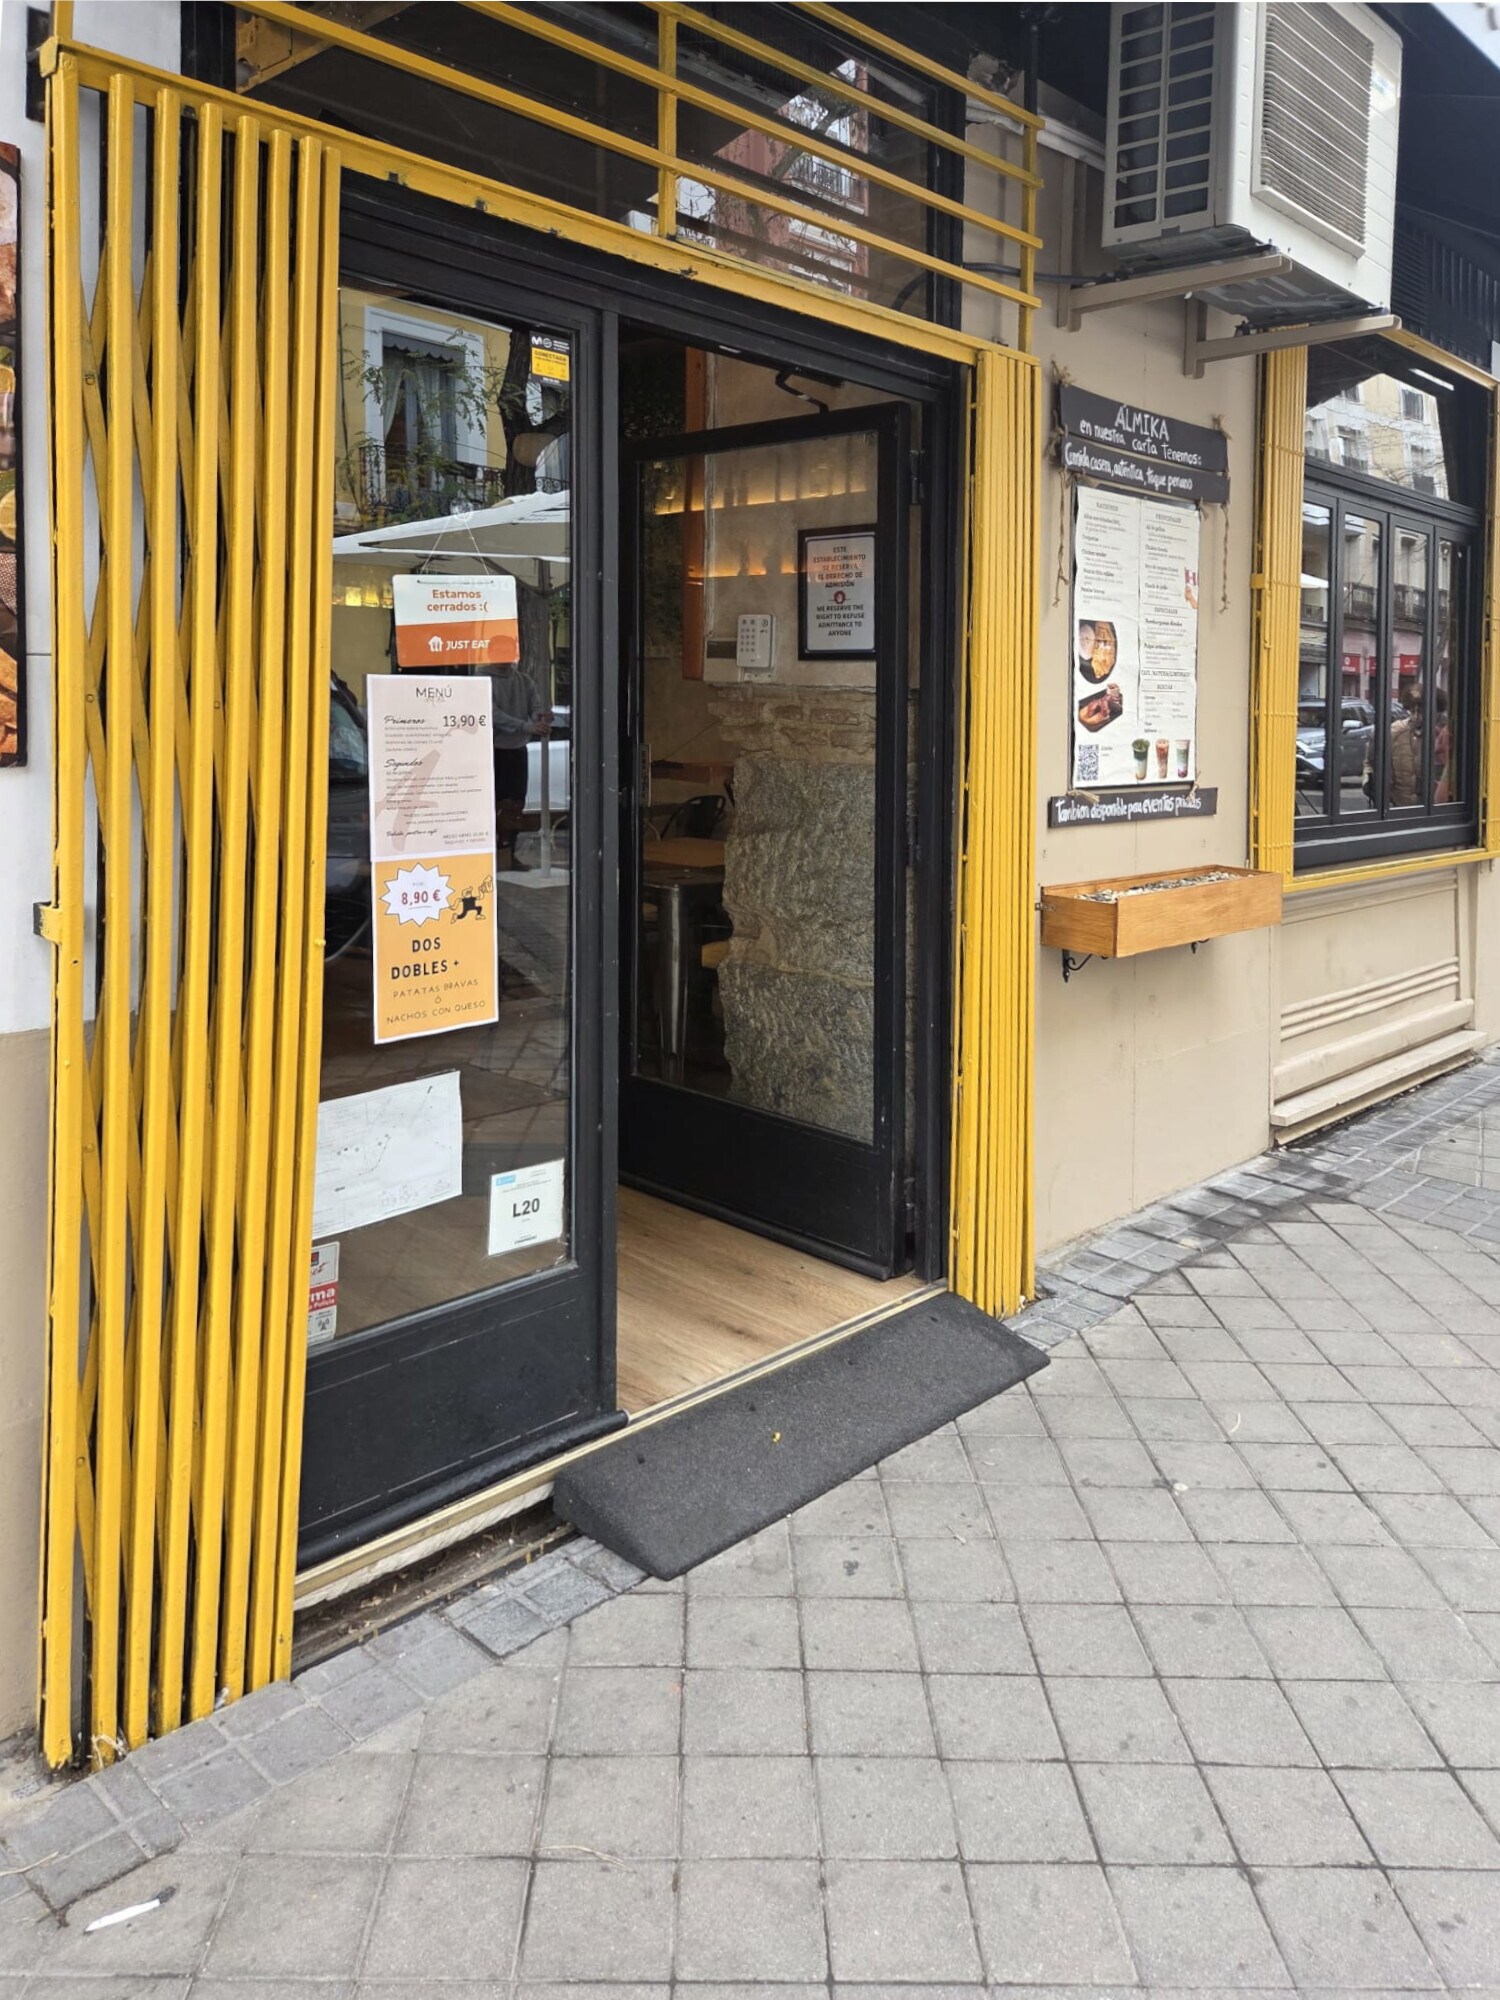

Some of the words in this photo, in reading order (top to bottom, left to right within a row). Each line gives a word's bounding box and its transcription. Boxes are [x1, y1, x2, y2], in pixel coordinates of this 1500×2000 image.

[1080, 419, 1092, 436] en
[1094, 425, 1126, 445] nuestra
[1132, 436, 1158, 455] carta
[1161, 442, 1202, 465] tenemos:
[1065, 442, 1090, 468] Comida
[1146, 466, 1167, 491] toque
[1167, 475, 1193, 493] peruano
[814, 554, 866, 563] ESTABLECIMIENTO
[432, 589, 481, 599] Estamos
[427, 601, 476, 612] cerrados
[445, 640, 470, 651] JUST
[471, 640, 491, 649] EAT
[415, 685, 452, 698] MENÚ
[384, 715, 425, 725] Primeros
[443, 715, 475, 728] 13,90
[478, 715, 486, 726] €
[384, 758, 423, 771] Segundos
[1127, 801, 1142, 820] para
[1143, 793, 1175, 813] eventos
[401, 890, 428, 905] 8,90
[433, 889, 440, 901] €
[412, 937, 441, 953] DOS
[391, 959, 448, 980] DOBLES
[393, 985, 440, 998] PATATAS
[443, 978, 478, 991] BRAVAS
[387, 1010, 427, 1024] NACHOS
[432, 1006, 450, 1016] CON
[454, 1000, 485, 1012] QUESO
[513, 1198, 540, 1218] L20
